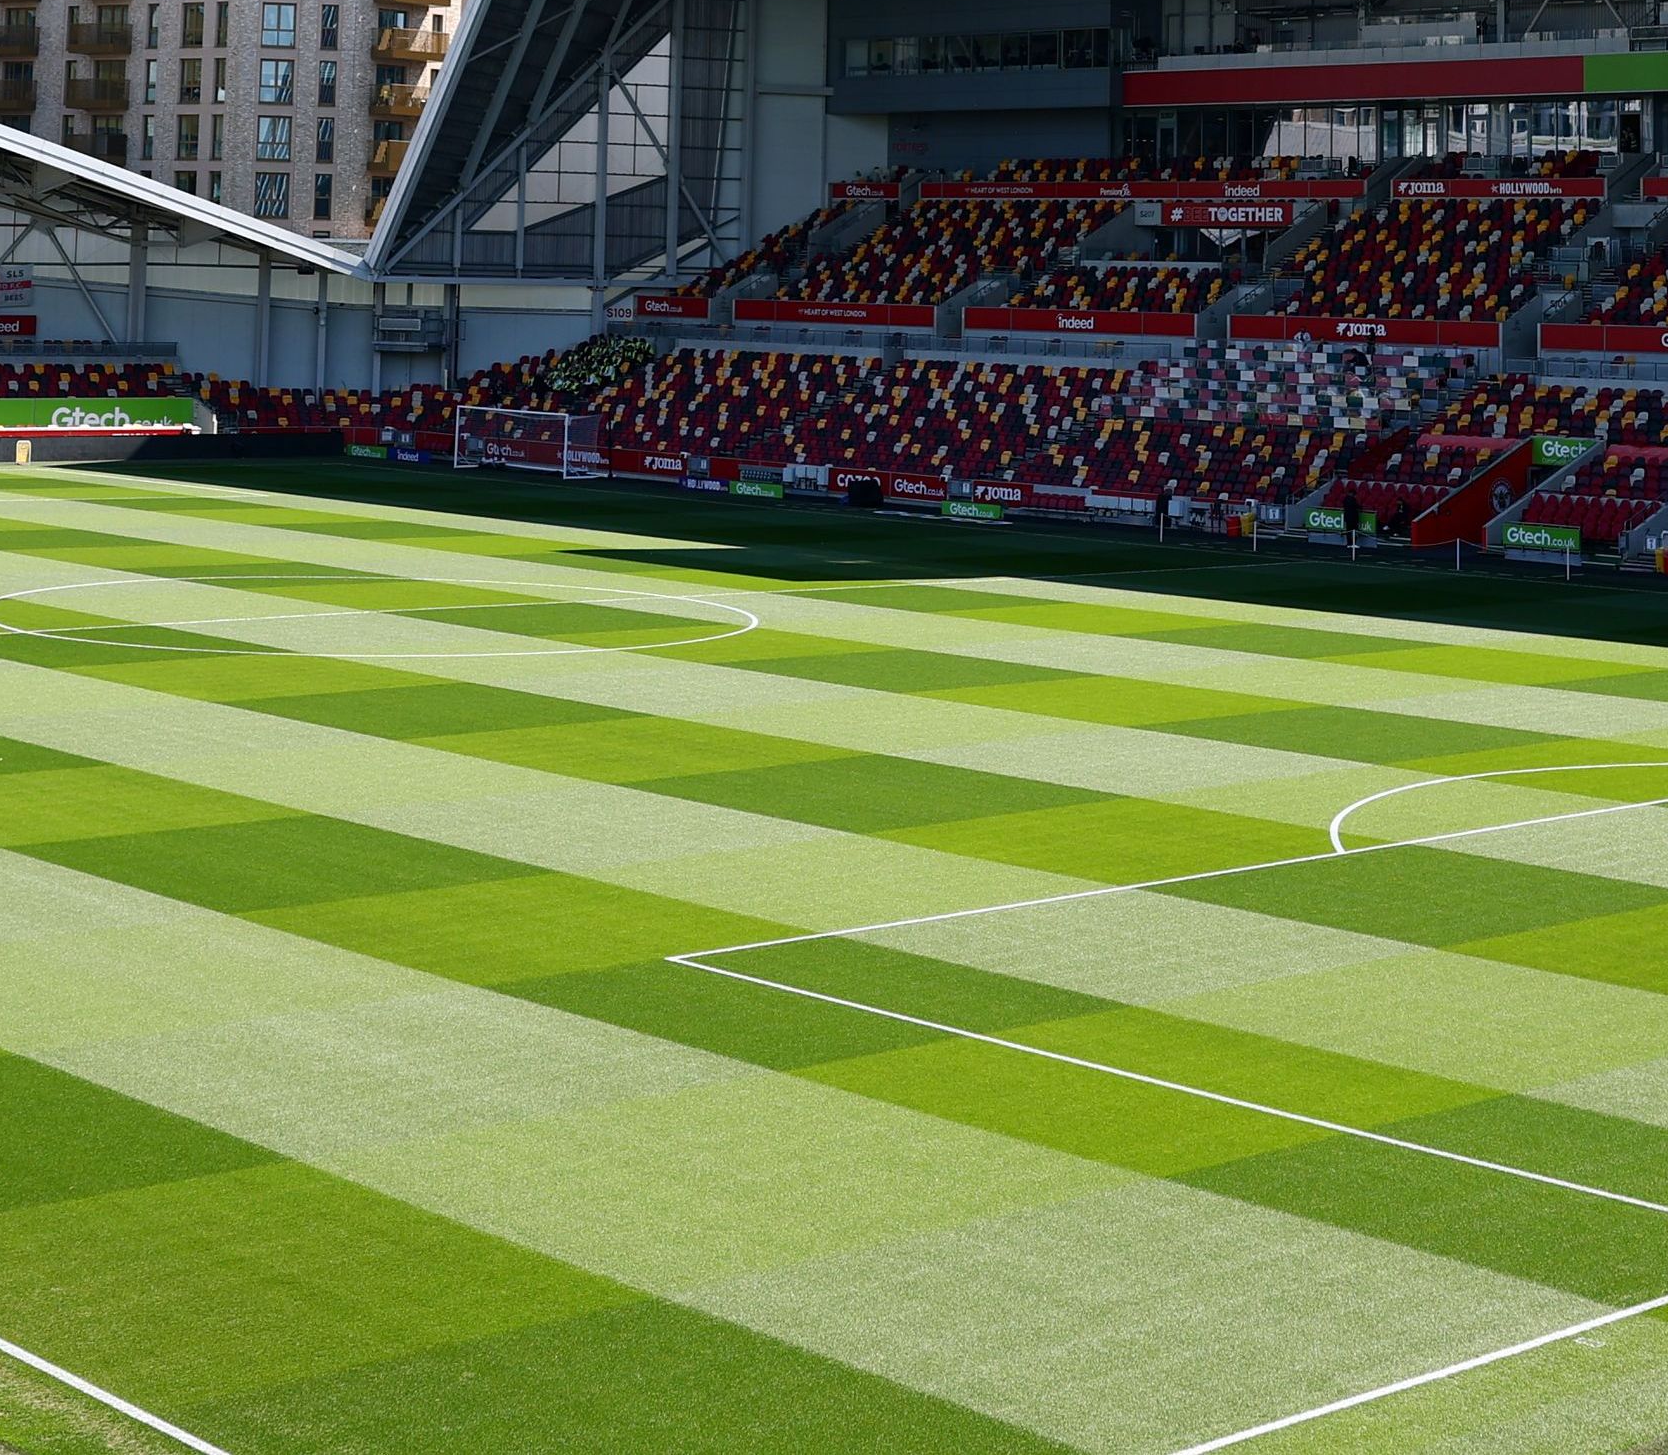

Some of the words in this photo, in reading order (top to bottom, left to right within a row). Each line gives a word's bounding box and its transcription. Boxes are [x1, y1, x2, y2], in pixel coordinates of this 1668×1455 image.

[1223, 183, 1260, 198] indeed
[606, 308, 633, 318] S109
[1056, 313, 1094, 329] indeed
[894, 478, 946, 497] Gtech.co.uk
[1507, 527, 1576, 548] Gtech.co.uk
